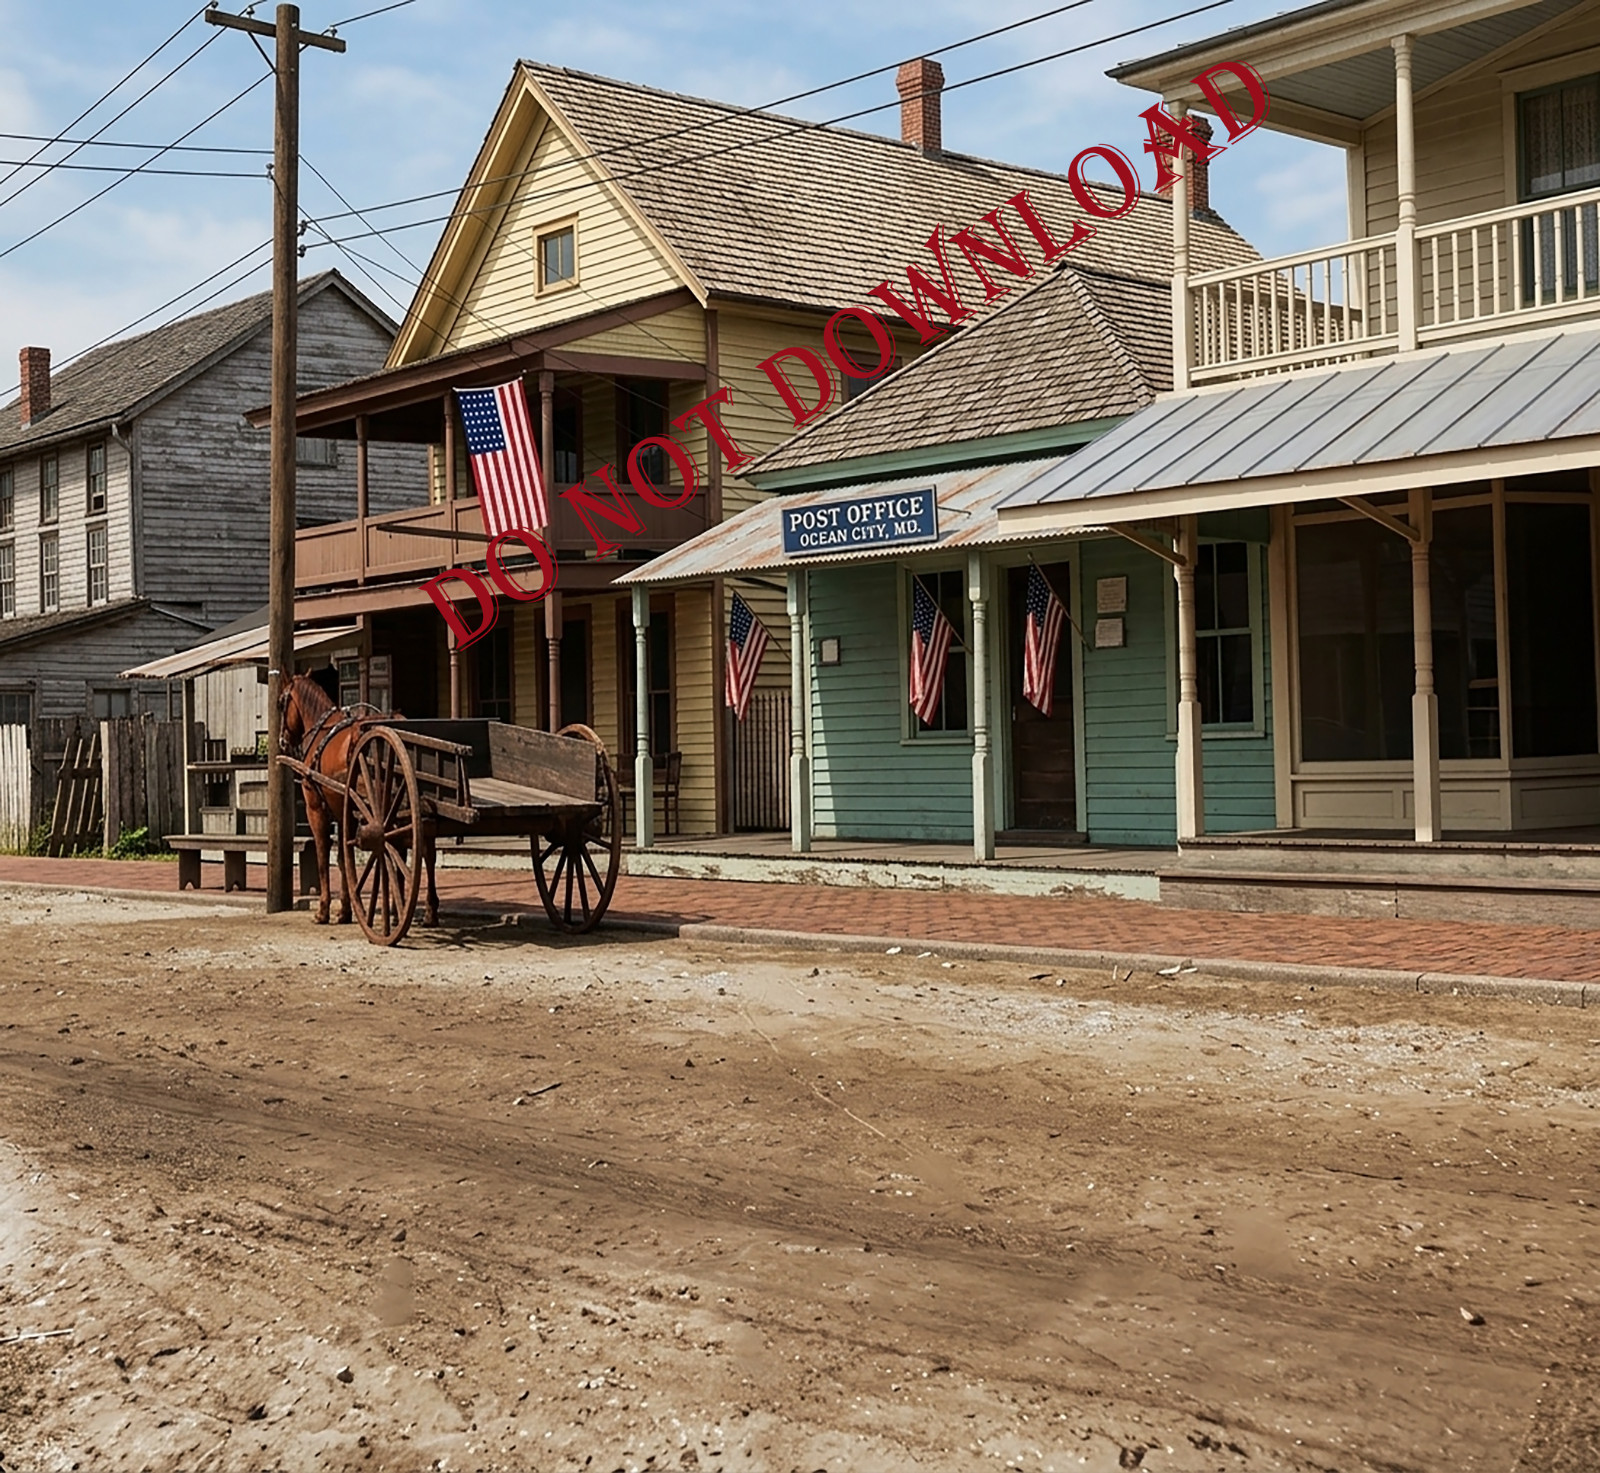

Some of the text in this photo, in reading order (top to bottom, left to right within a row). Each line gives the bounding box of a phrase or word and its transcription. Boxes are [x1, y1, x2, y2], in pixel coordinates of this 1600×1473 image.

[790, 496, 924, 532] POST OFFICE
[800, 519, 922, 547] OCEAN CITY, MD.
